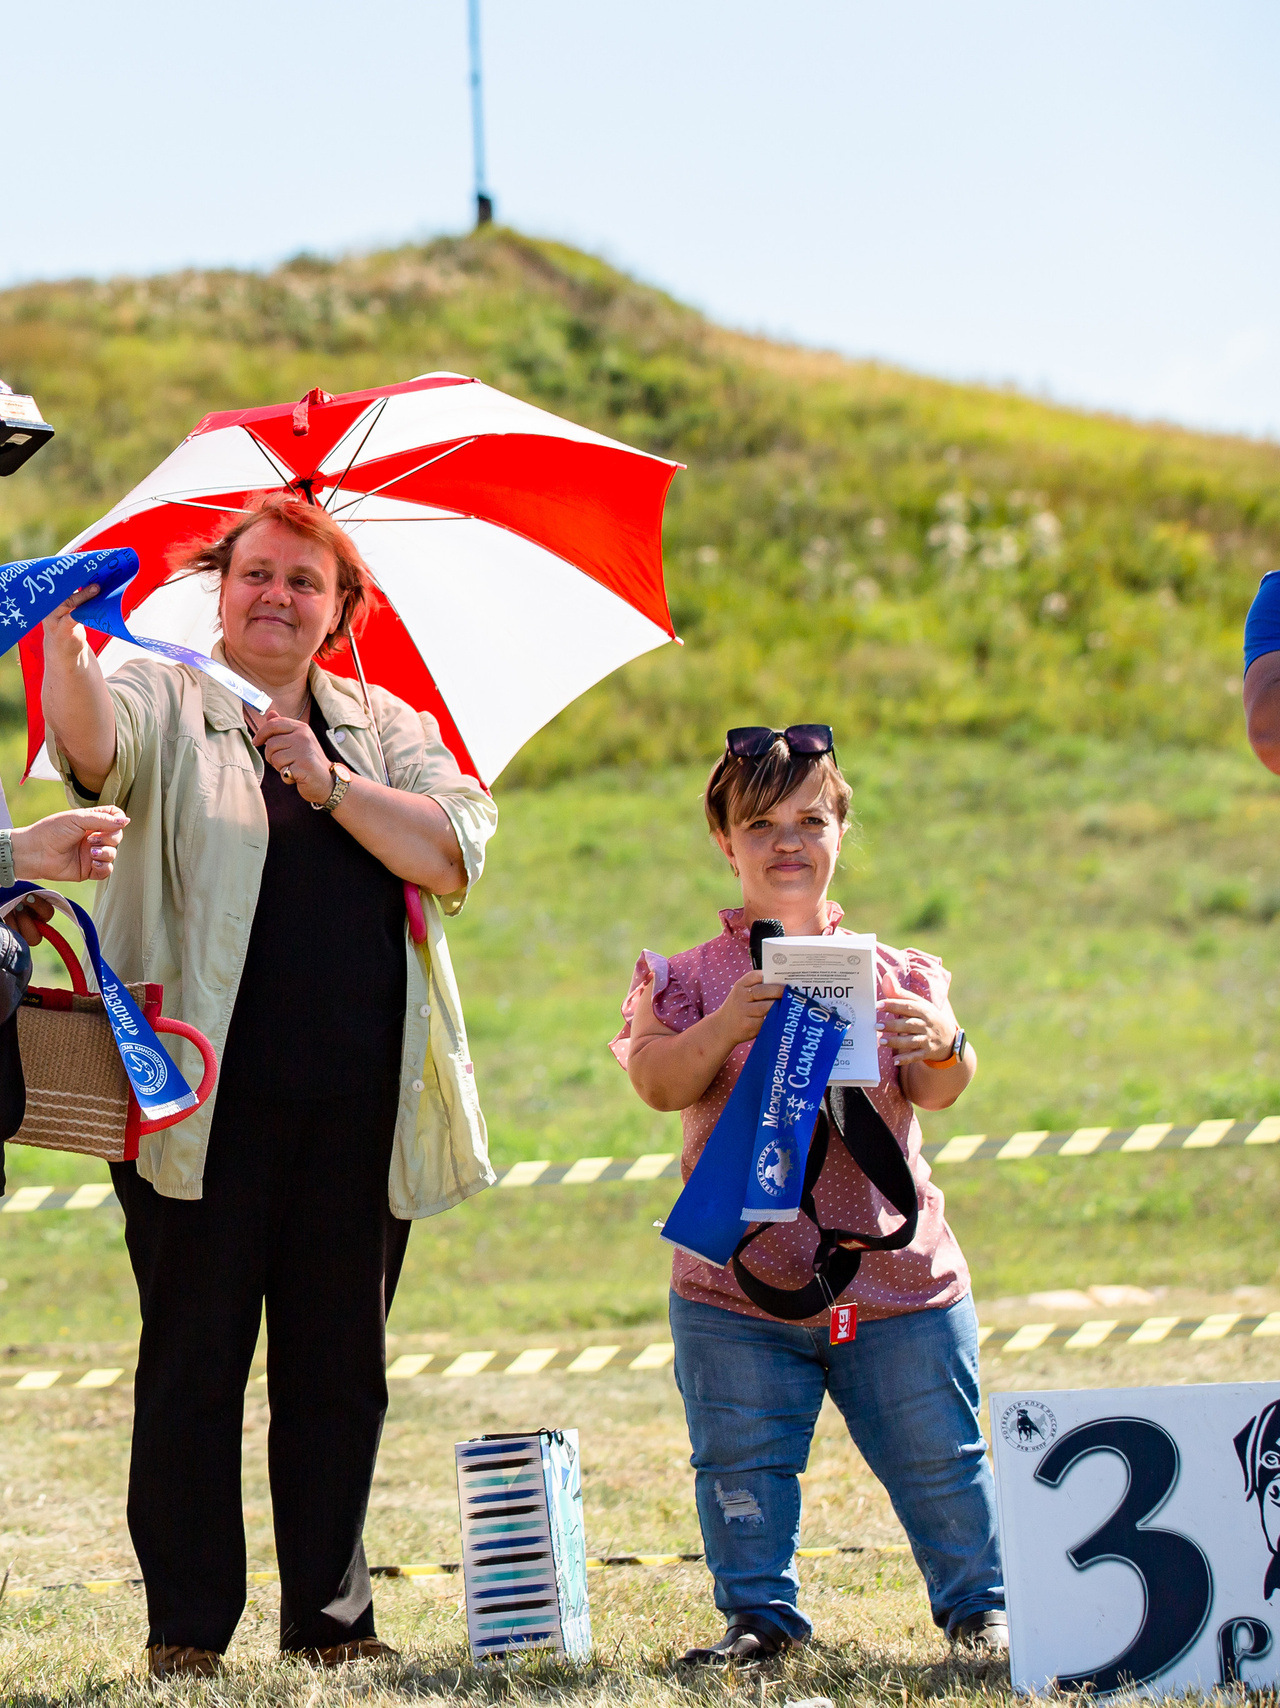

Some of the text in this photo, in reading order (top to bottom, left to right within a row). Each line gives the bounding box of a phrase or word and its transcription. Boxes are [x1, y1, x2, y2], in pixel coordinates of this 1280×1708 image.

[83, 559, 98, 573] 13
[762, 992, 808, 1129] Межрегиональный
[787, 1024, 825, 1089] Самый
[837, 1308, 851, 1339] K9
[1033, 1416, 1213, 1696] 3
